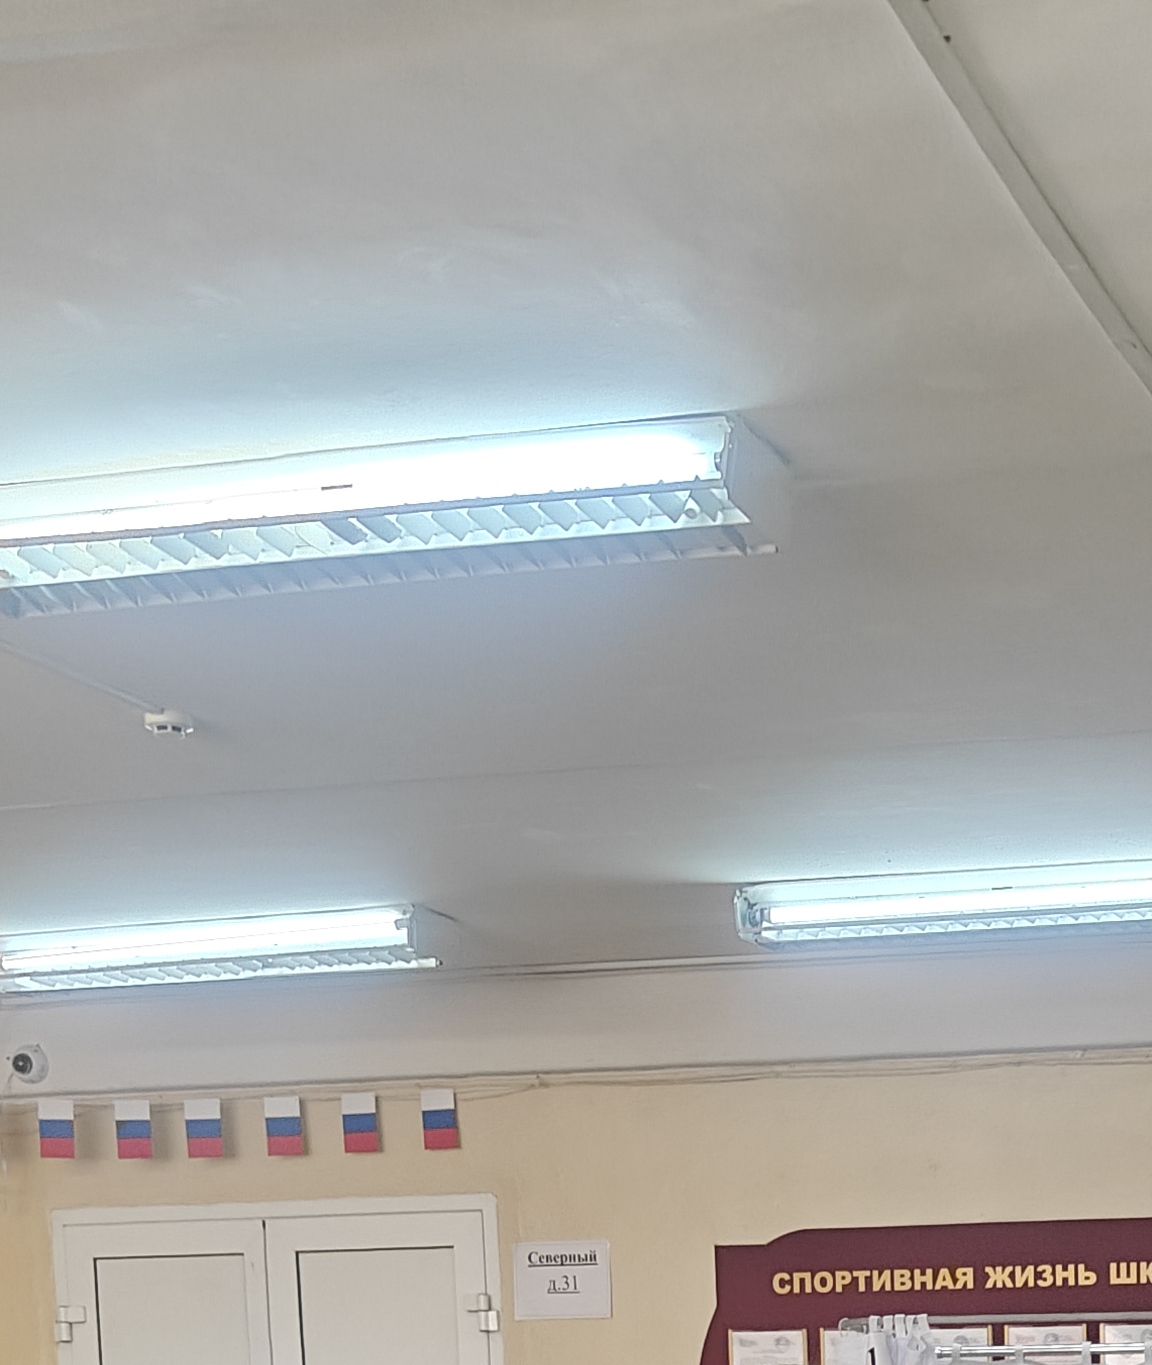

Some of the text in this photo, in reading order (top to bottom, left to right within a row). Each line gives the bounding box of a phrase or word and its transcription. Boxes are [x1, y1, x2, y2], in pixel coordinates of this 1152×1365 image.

[528, 1250, 597, 1266] Северный
[547, 1275, 579, 1293] д.31
[772, 1267, 974, 1294] СПОРТИВНАЯ
[984, 1263, 1097, 1289] ЖИЗНЬ
